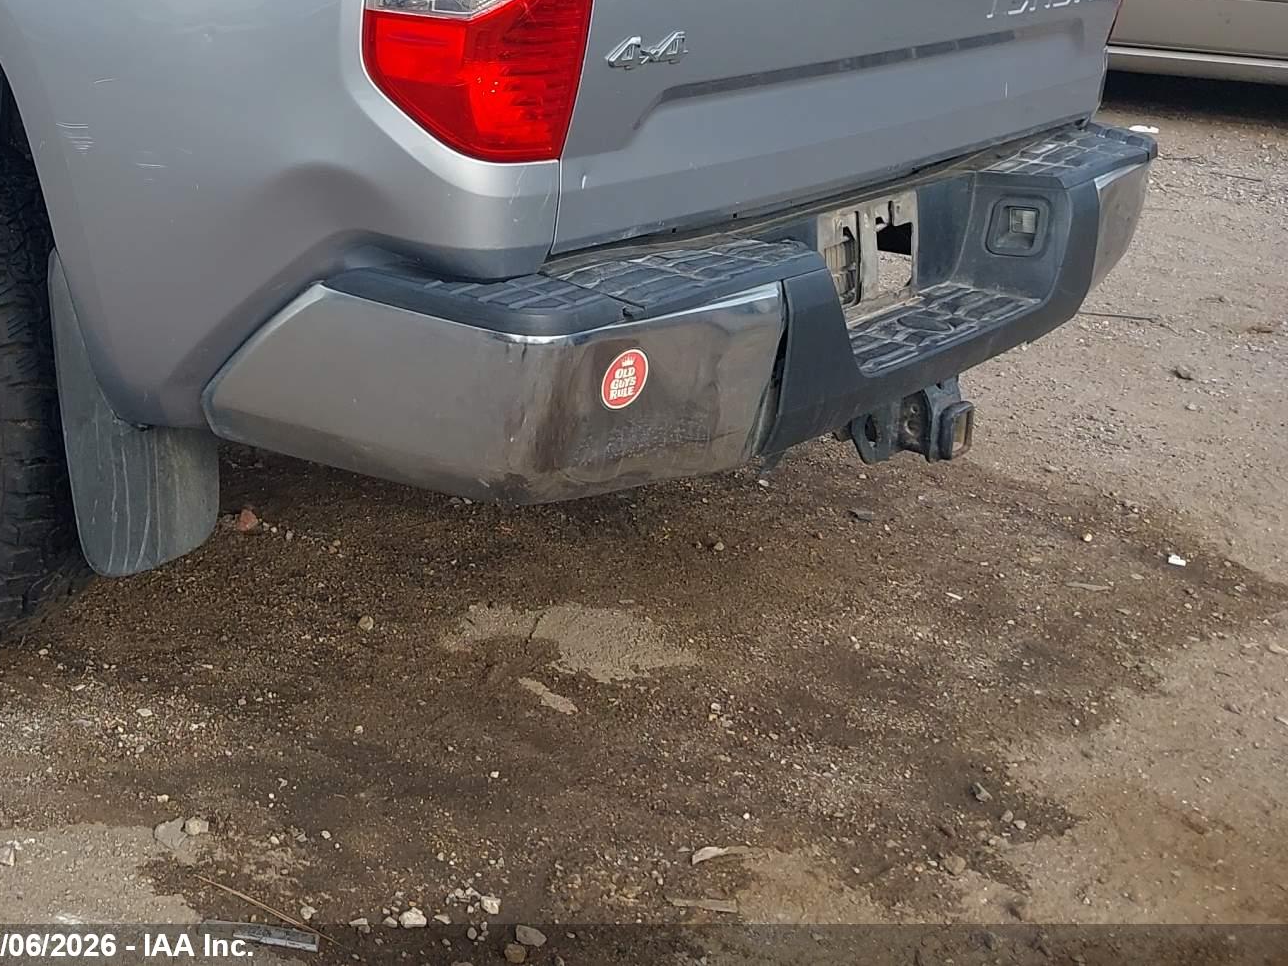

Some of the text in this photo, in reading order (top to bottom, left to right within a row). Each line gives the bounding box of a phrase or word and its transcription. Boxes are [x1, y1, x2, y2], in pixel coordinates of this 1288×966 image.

[614, 366, 636, 379] OLD
[610, 376, 637, 390] GUYS
[609, 386, 636, 401] RULE
